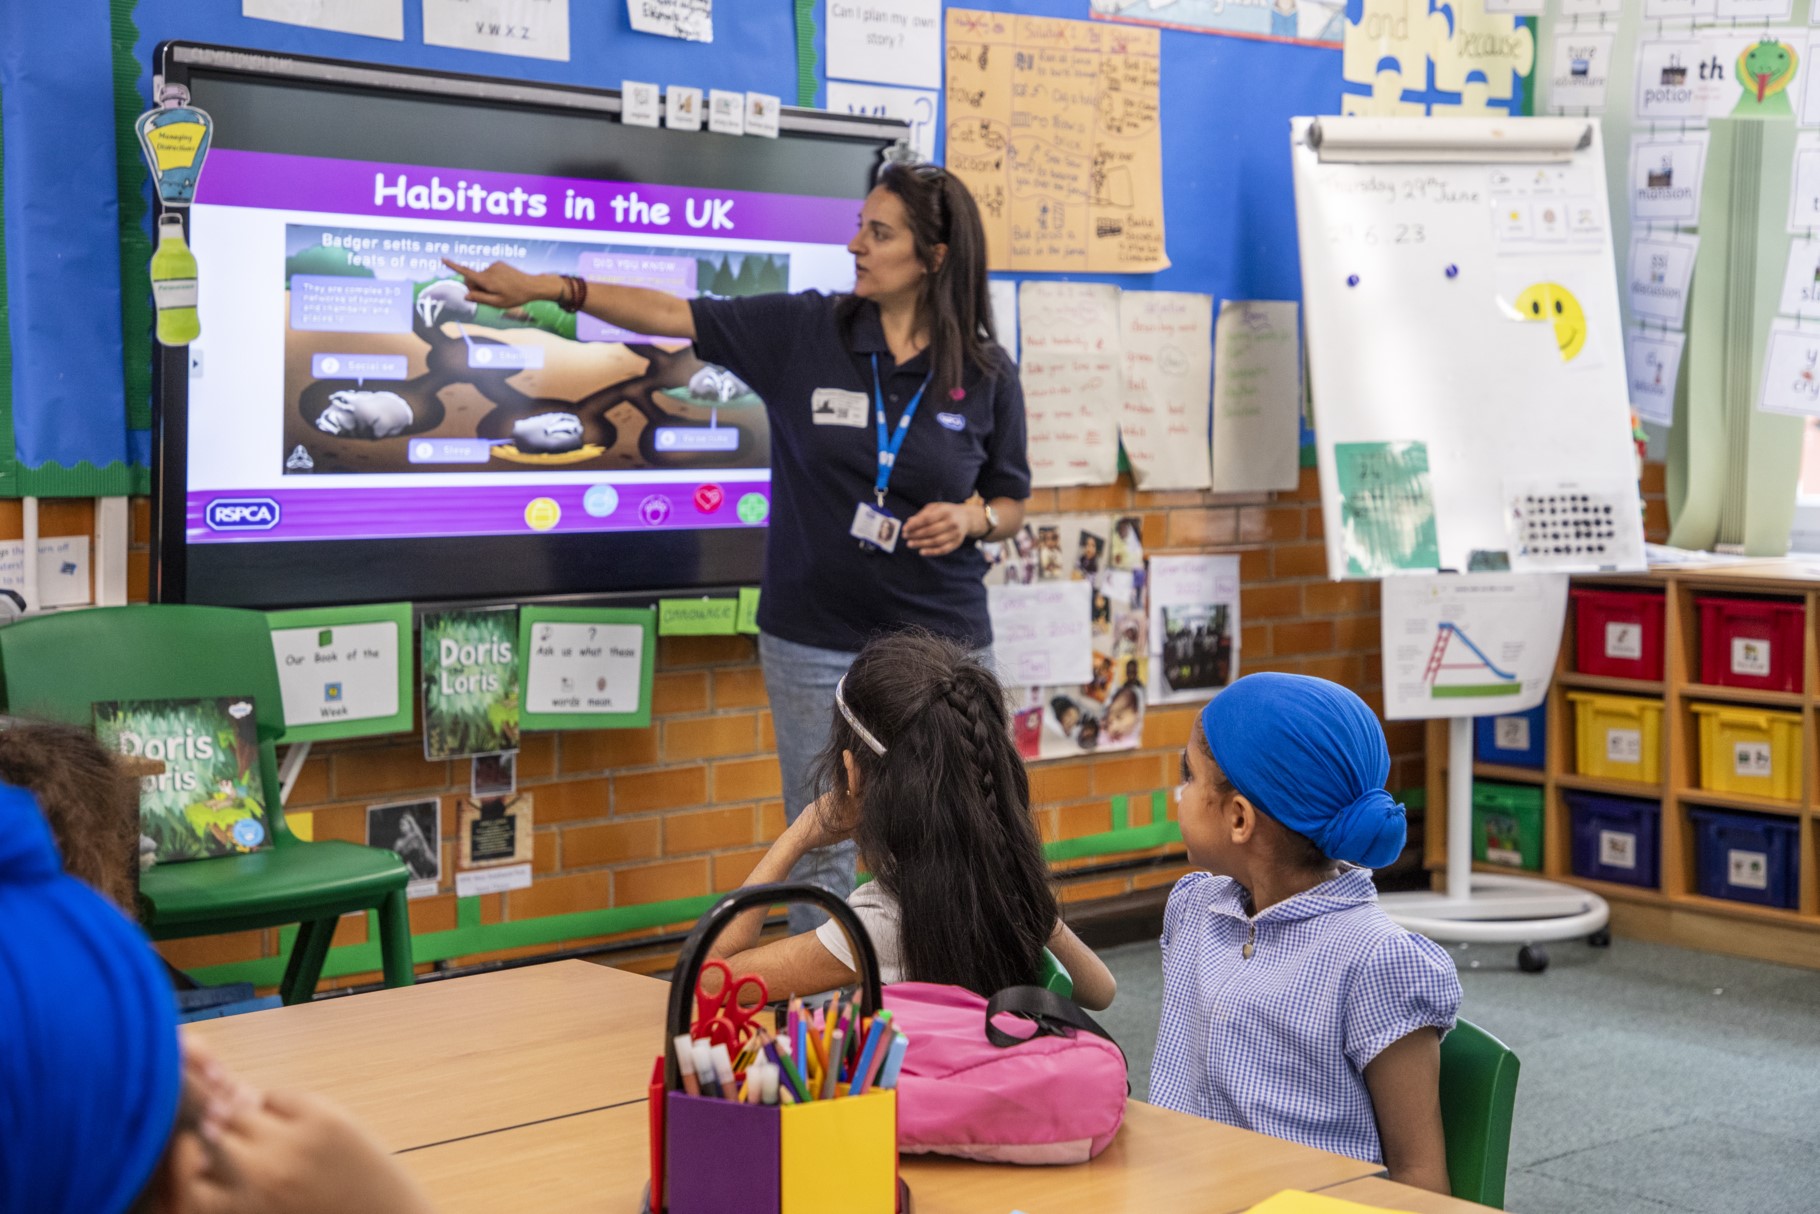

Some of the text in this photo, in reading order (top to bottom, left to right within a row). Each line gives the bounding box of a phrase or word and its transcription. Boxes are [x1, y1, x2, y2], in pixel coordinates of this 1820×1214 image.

[831, 3, 855, 18] Can
[863, 8, 886, 23] plan
[890, 13, 908, 28] my
[1366, 9, 1409, 41] and
[866, 33, 895, 48] story
[1459, 27, 1522, 58] because
[1567, 45, 1597, 59] ture
[1699, 56, 1724, 80] th
[1553, 75, 1606, 88] adventure
[374, 172, 735, 230] Habitats in the UK
[1433, 190, 1481, 205] June
[1637, 187, 1693, 201] mansion
[321, 232, 528, 258] Badger setts are incredible
[347, 252, 382, 267] feats
[390, 253, 405, 267] of
[1792, 381, 1820, 401] cry
[215, 505, 272, 522] RSPCA
[285, 648, 380, 666] Our Book of the
[440, 634, 513, 667] Doris
[537, 646, 635, 658] Ask us what these
[441, 668, 499, 695] Loris
[320, 704, 349, 718] Week
[552, 697, 580, 707] words
[119, 727, 214, 761] Doris
[141, 766, 197, 793] oris
